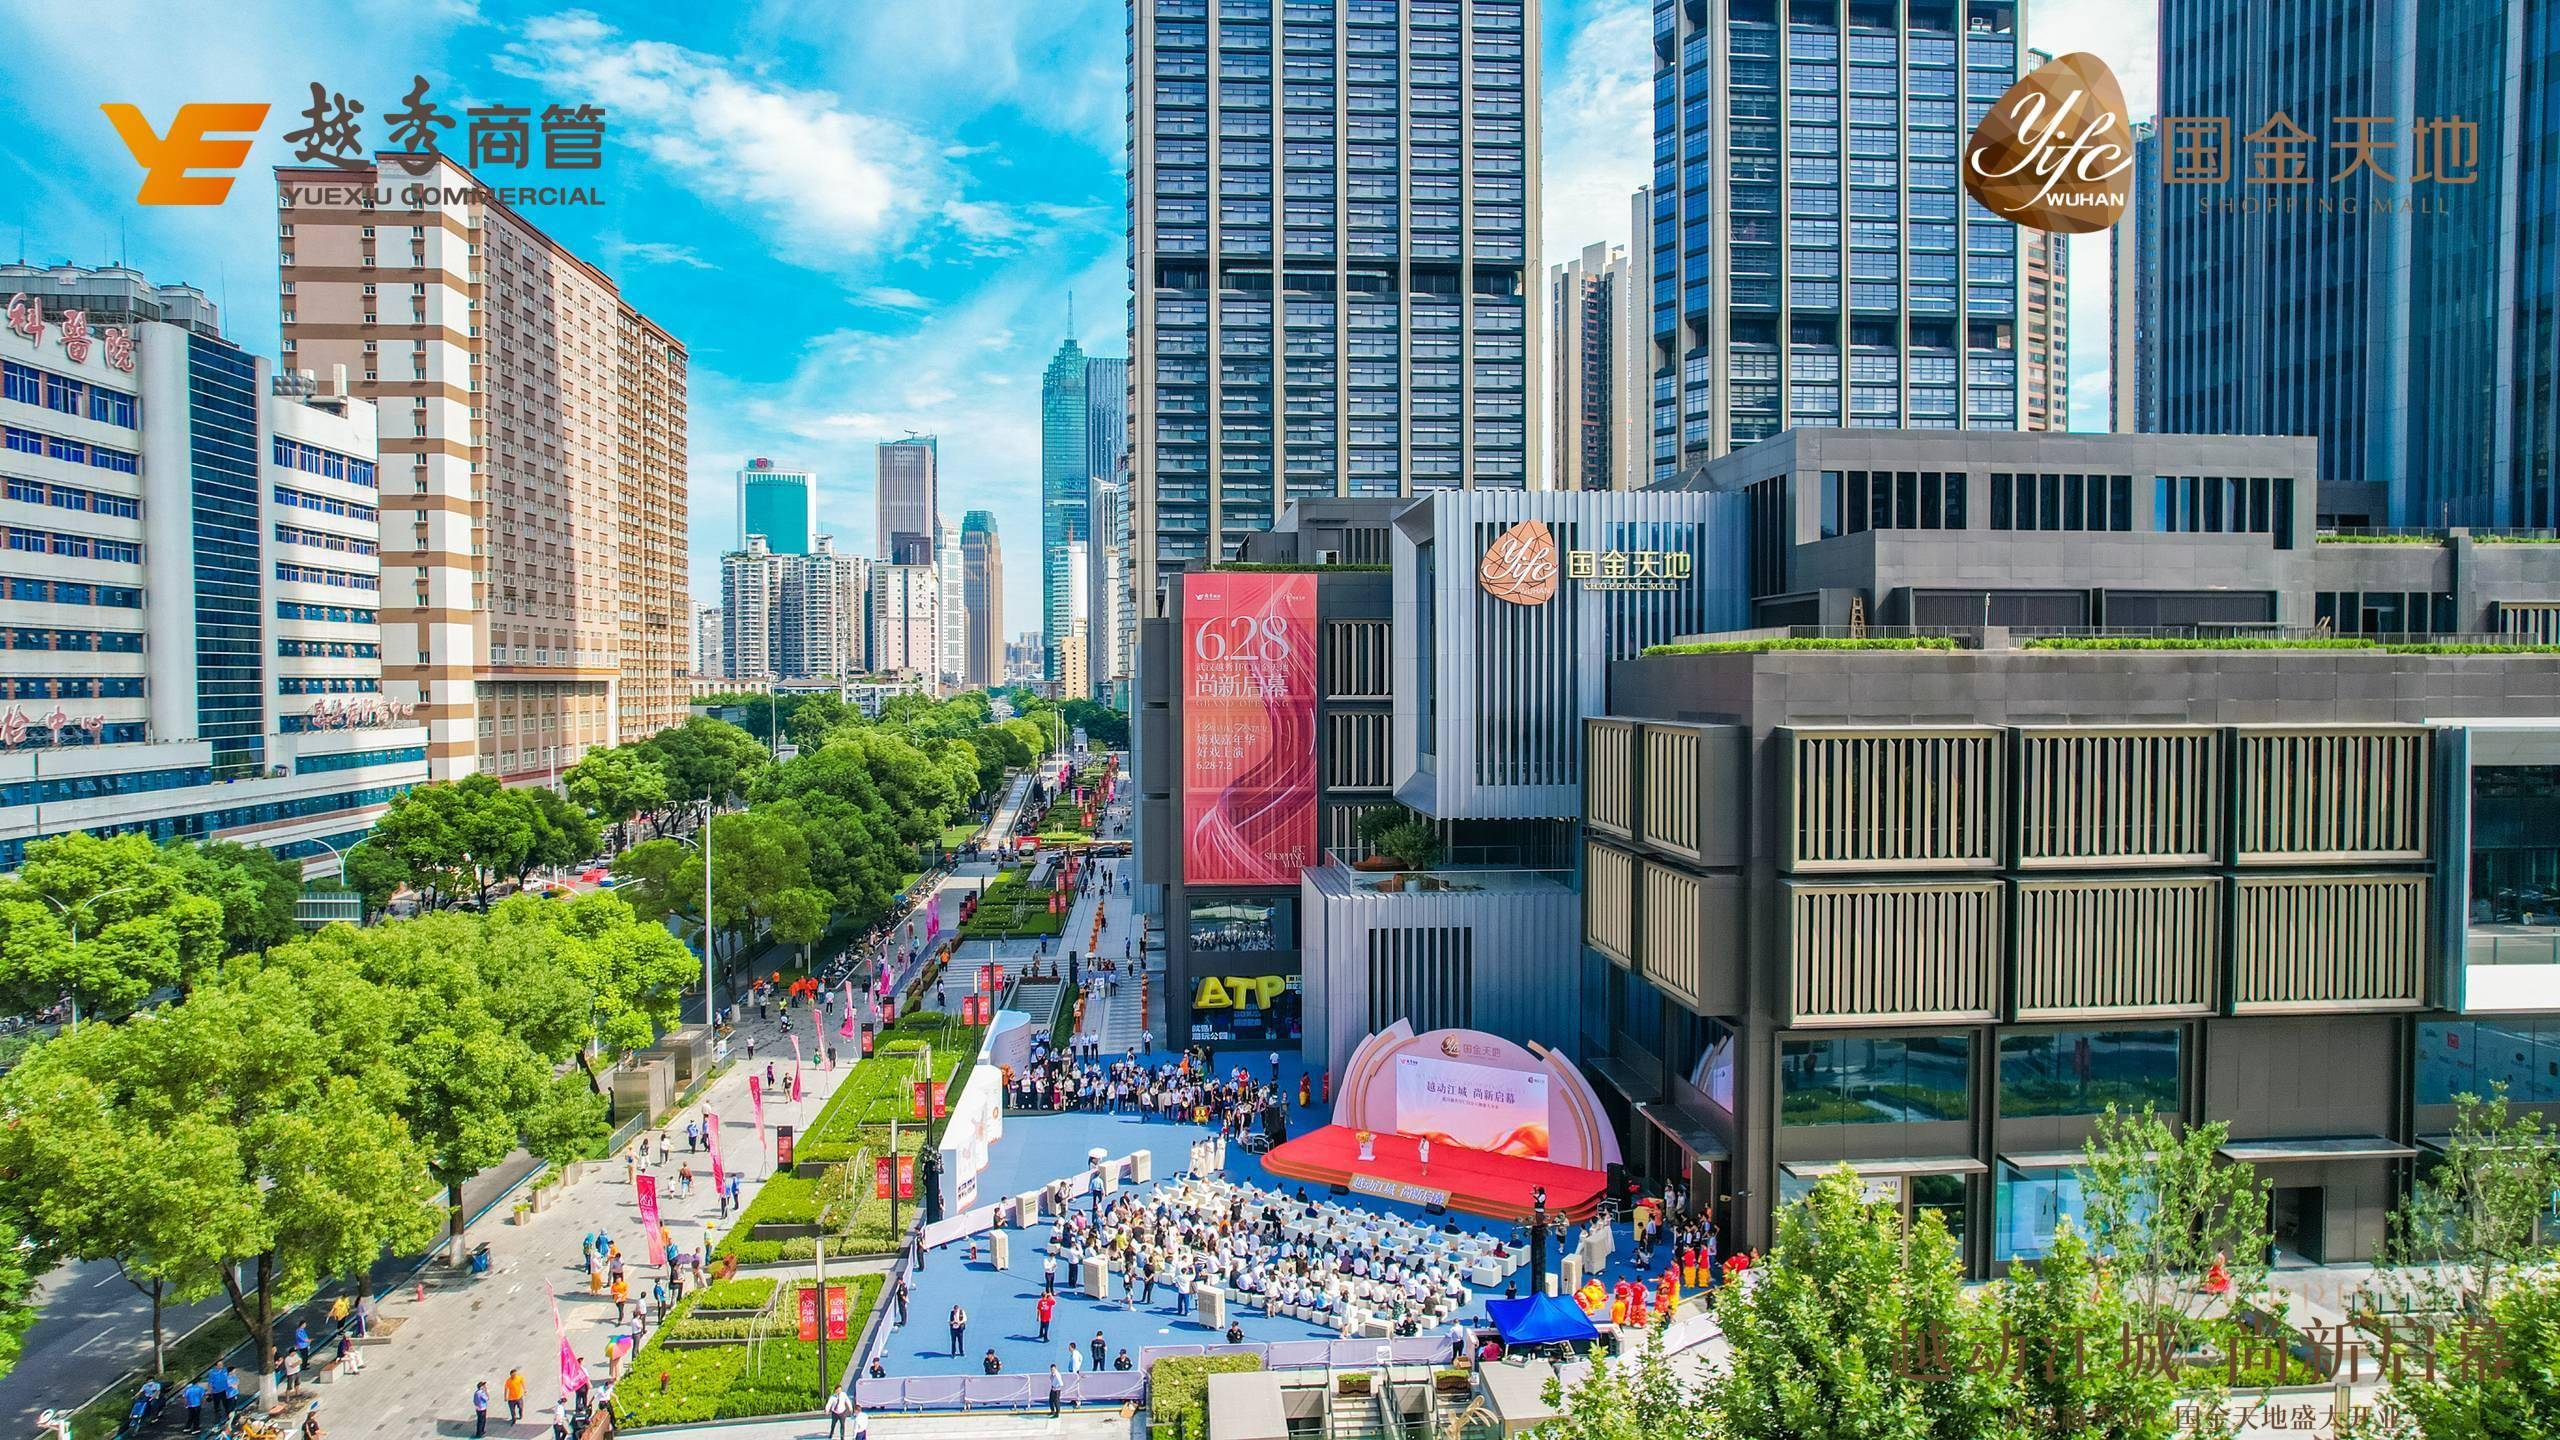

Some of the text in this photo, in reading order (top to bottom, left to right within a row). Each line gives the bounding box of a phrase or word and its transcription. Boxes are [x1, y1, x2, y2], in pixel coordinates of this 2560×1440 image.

[1567, 549, 1691, 580] 国金天地
[1519, 586, 1551, 595] WUHAN
[1583, 582, 1648, 592] SHOPPING
[1195, 615, 1290, 662] 6.28
[1195, 673, 1289, 698] 尚新启幕
[1192, 975, 1286, 1010] ATP
[1426, 1080, 1468, 1098] 越动江城
[1472, 1087, 1516, 1105] 尚新启幕
